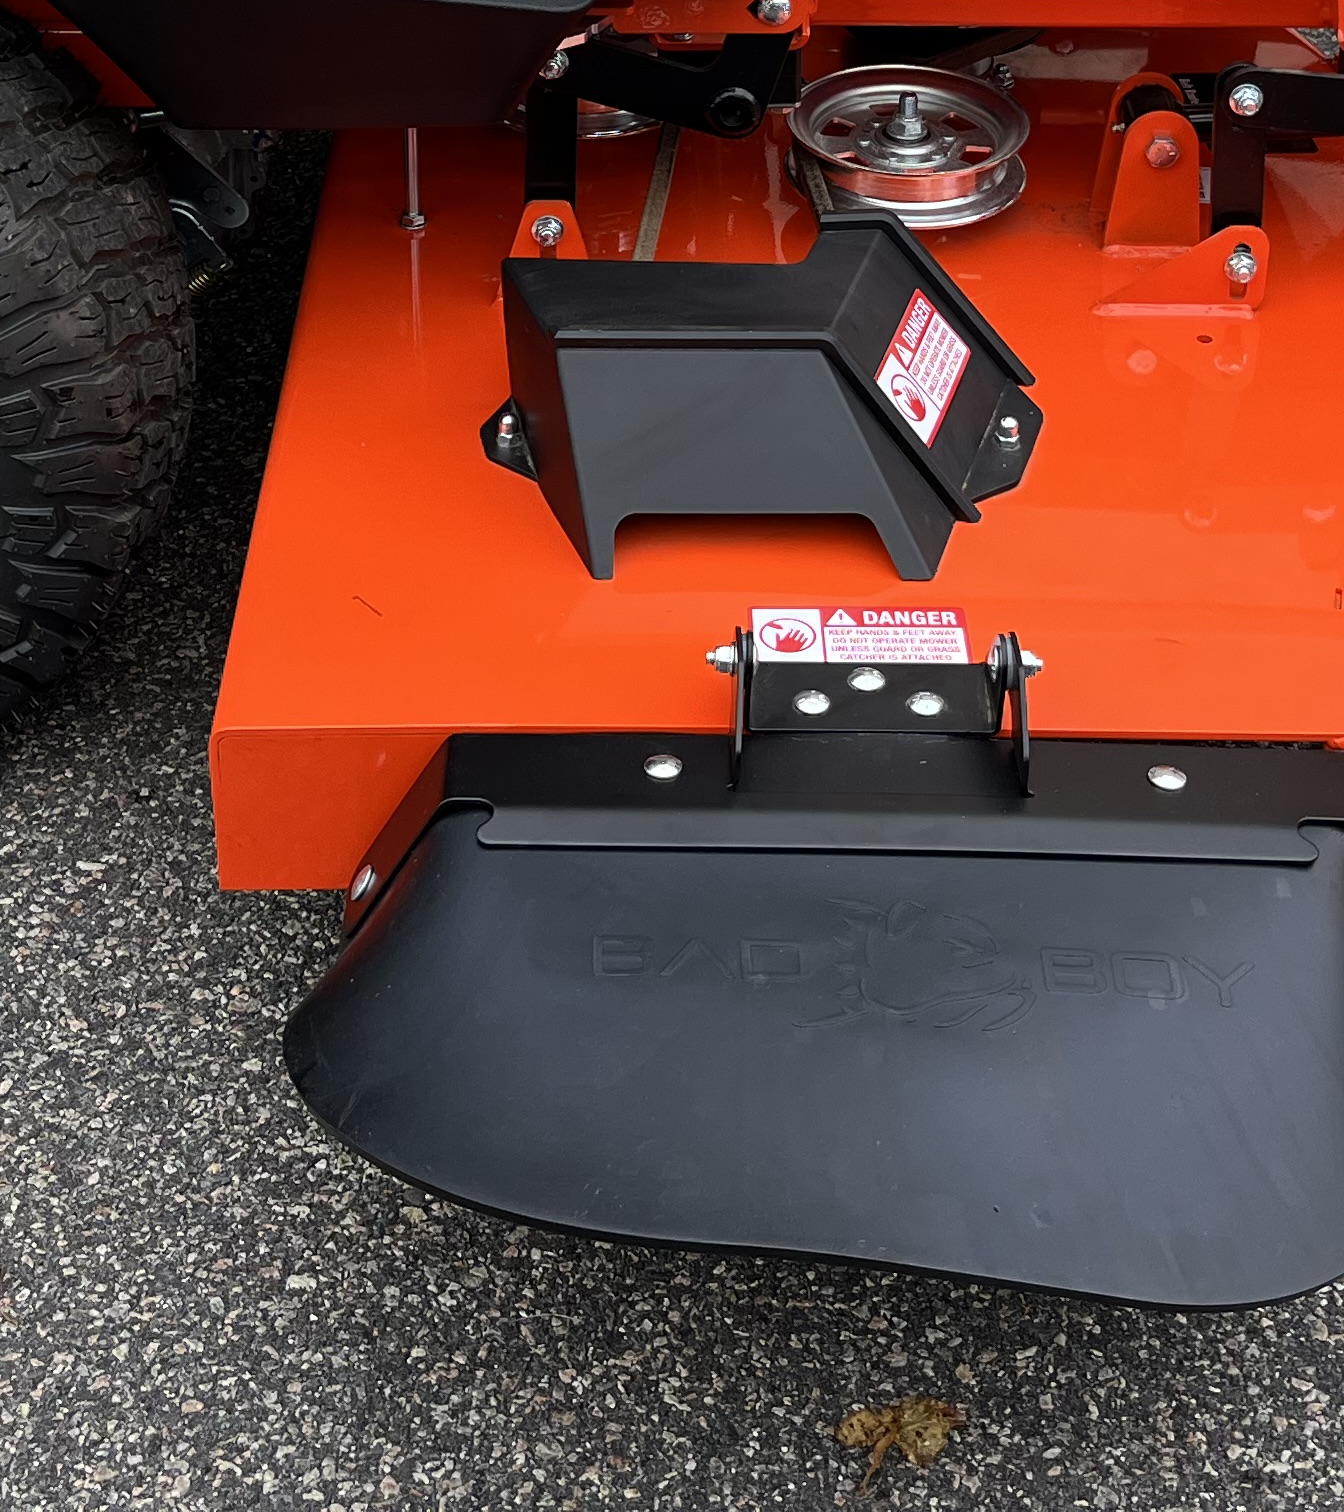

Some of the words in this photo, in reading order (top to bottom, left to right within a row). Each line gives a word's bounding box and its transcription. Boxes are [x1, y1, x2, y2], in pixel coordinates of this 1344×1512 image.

[901, 298, 931, 349] DANGER
[863, 610, 957, 625] DANGER
[592, 935, 803, 980] BAD
[1041, 946, 1254, 1008] BOY
